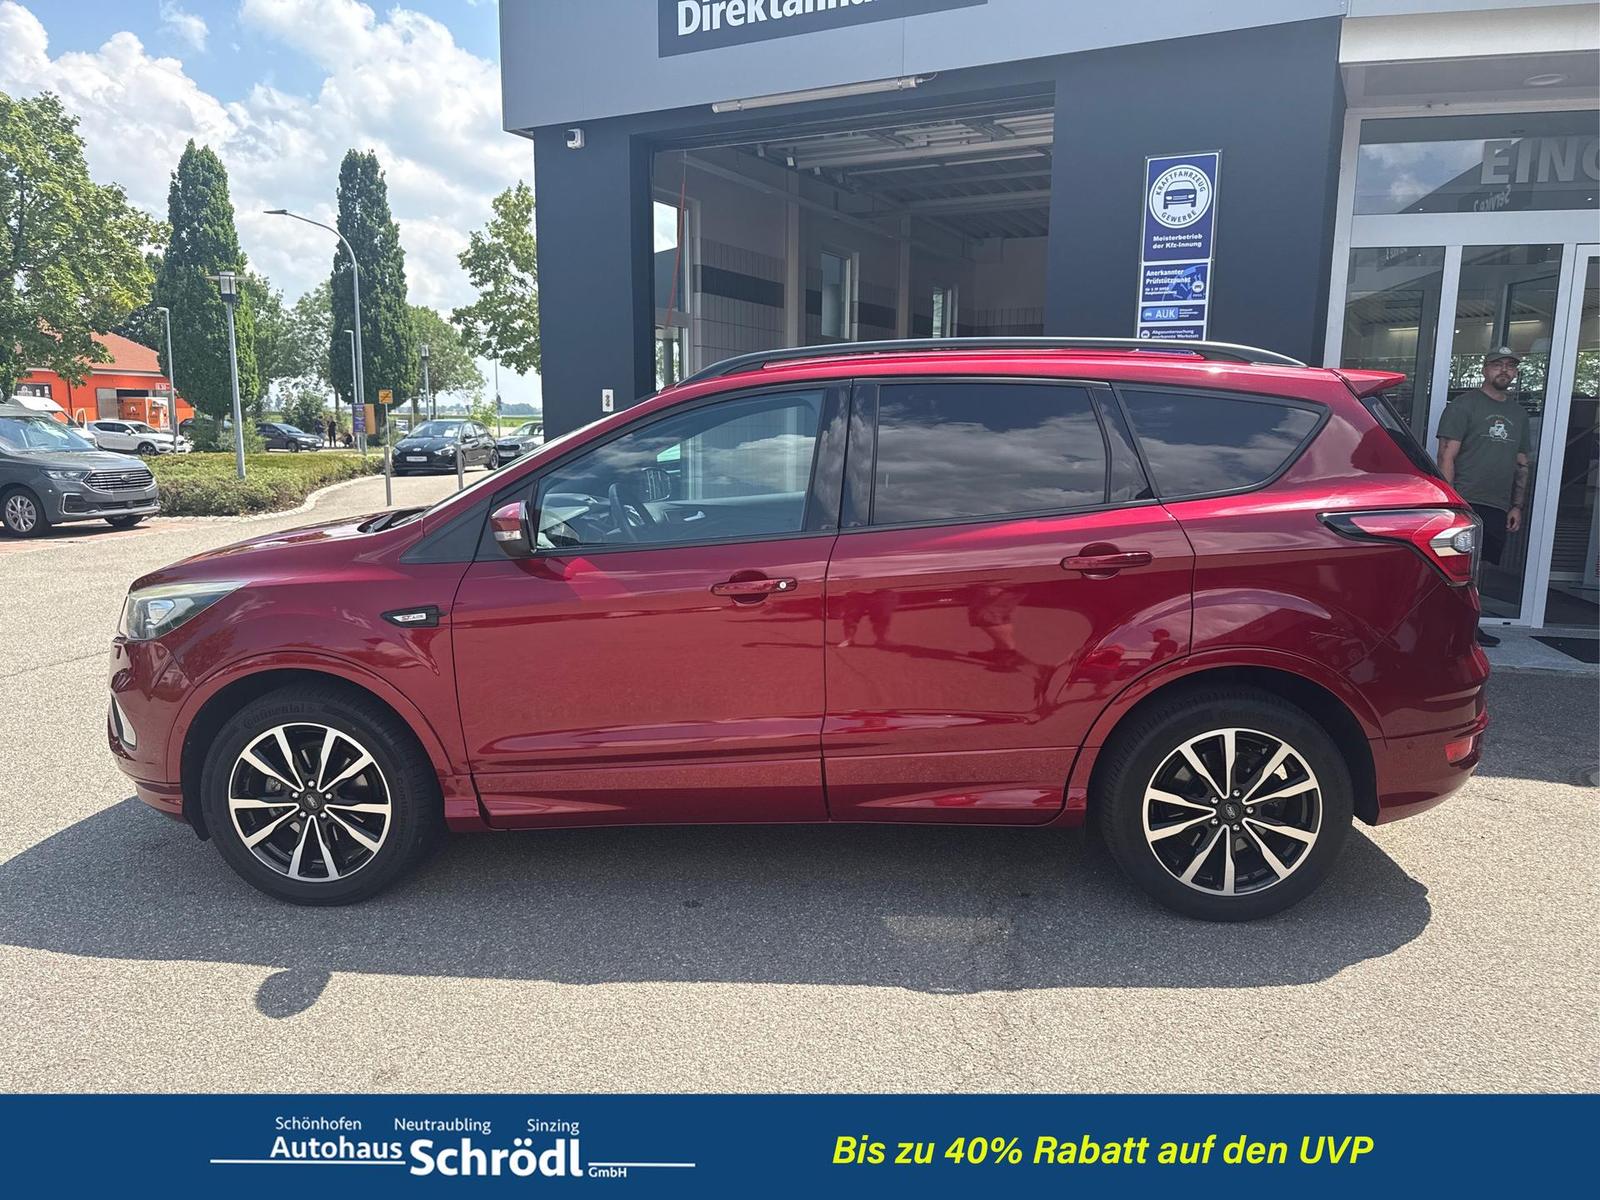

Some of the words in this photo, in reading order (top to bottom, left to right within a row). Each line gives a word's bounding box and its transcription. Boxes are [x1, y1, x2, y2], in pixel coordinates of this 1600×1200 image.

[1156, 170, 1206, 195] KRAFTFAHRZEUG
[1162, 210, 1197, 222] GEWERBE
[1152, 234, 1203, 242] Meisterbetrieb
[1165, 241, 1202, 249] Kfz-Innung
[1155, 310, 1176, 318] AUK
